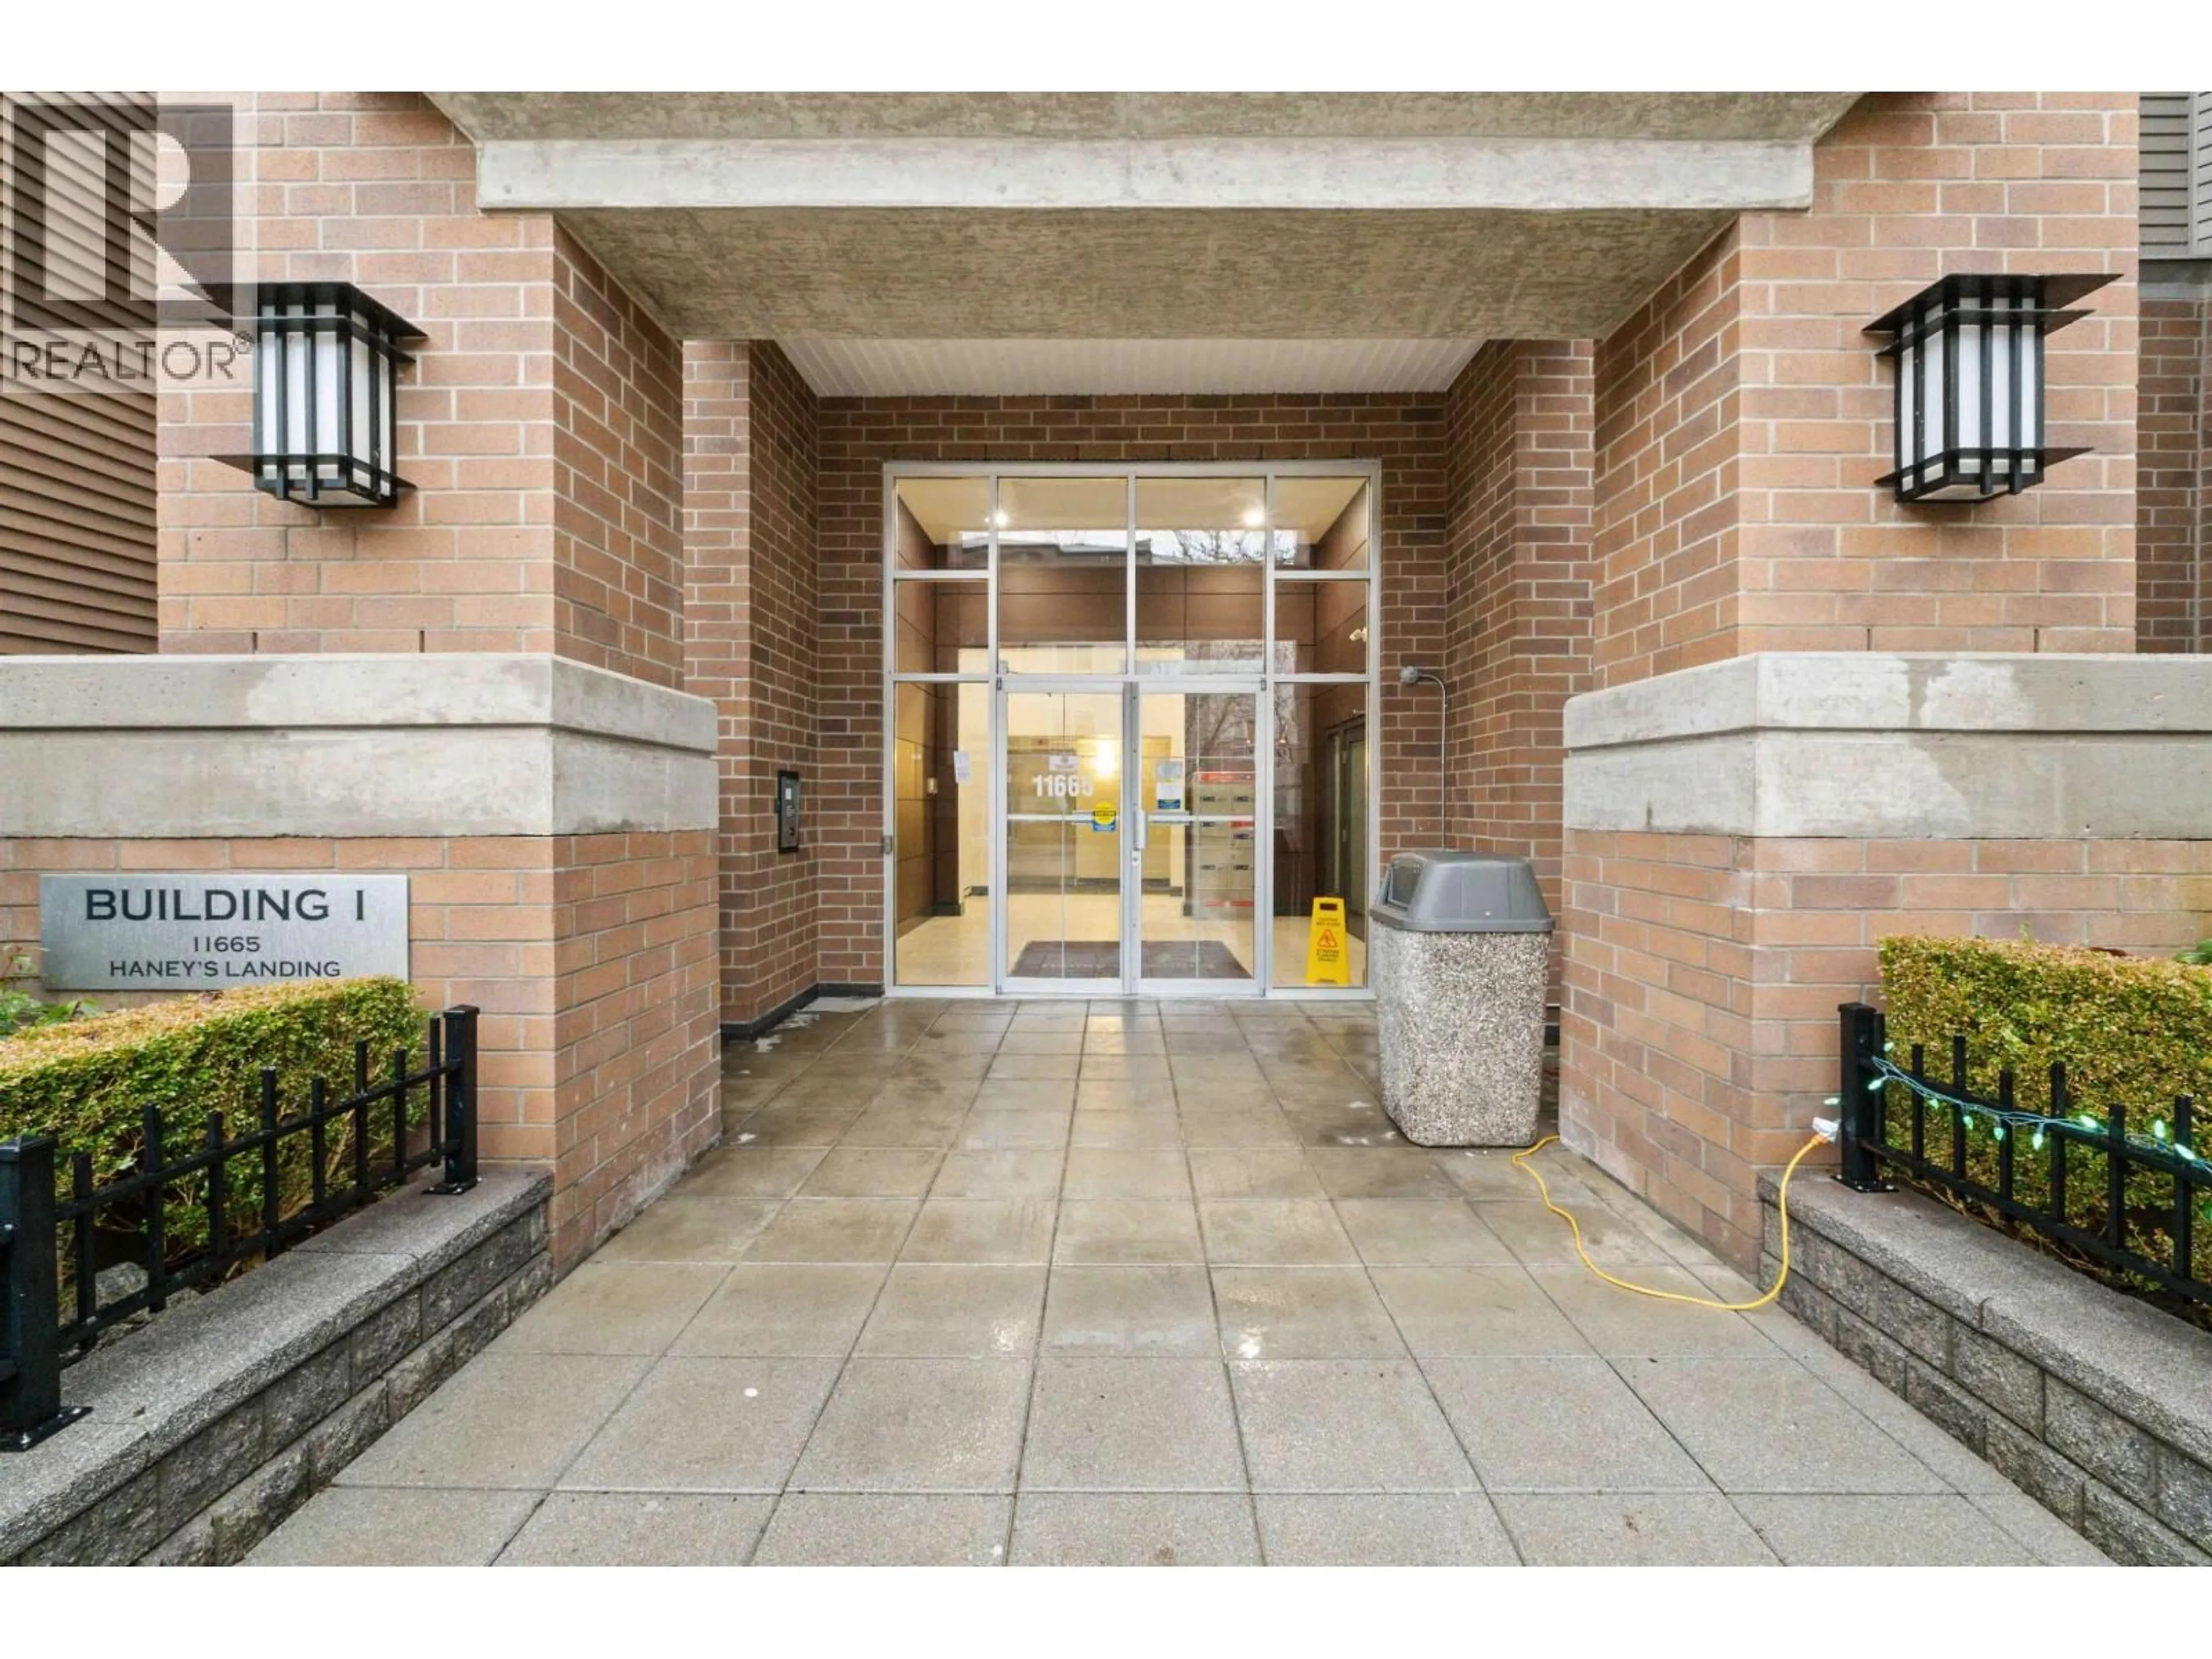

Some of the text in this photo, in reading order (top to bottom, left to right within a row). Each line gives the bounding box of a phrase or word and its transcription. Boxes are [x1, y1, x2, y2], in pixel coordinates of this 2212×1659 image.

[1032, 774, 1093, 797] 11665
[85, 889, 329, 921] BUILDING
[193, 935, 261, 953] 11665
[109, 960, 341, 978] HANEY'S LANDING
